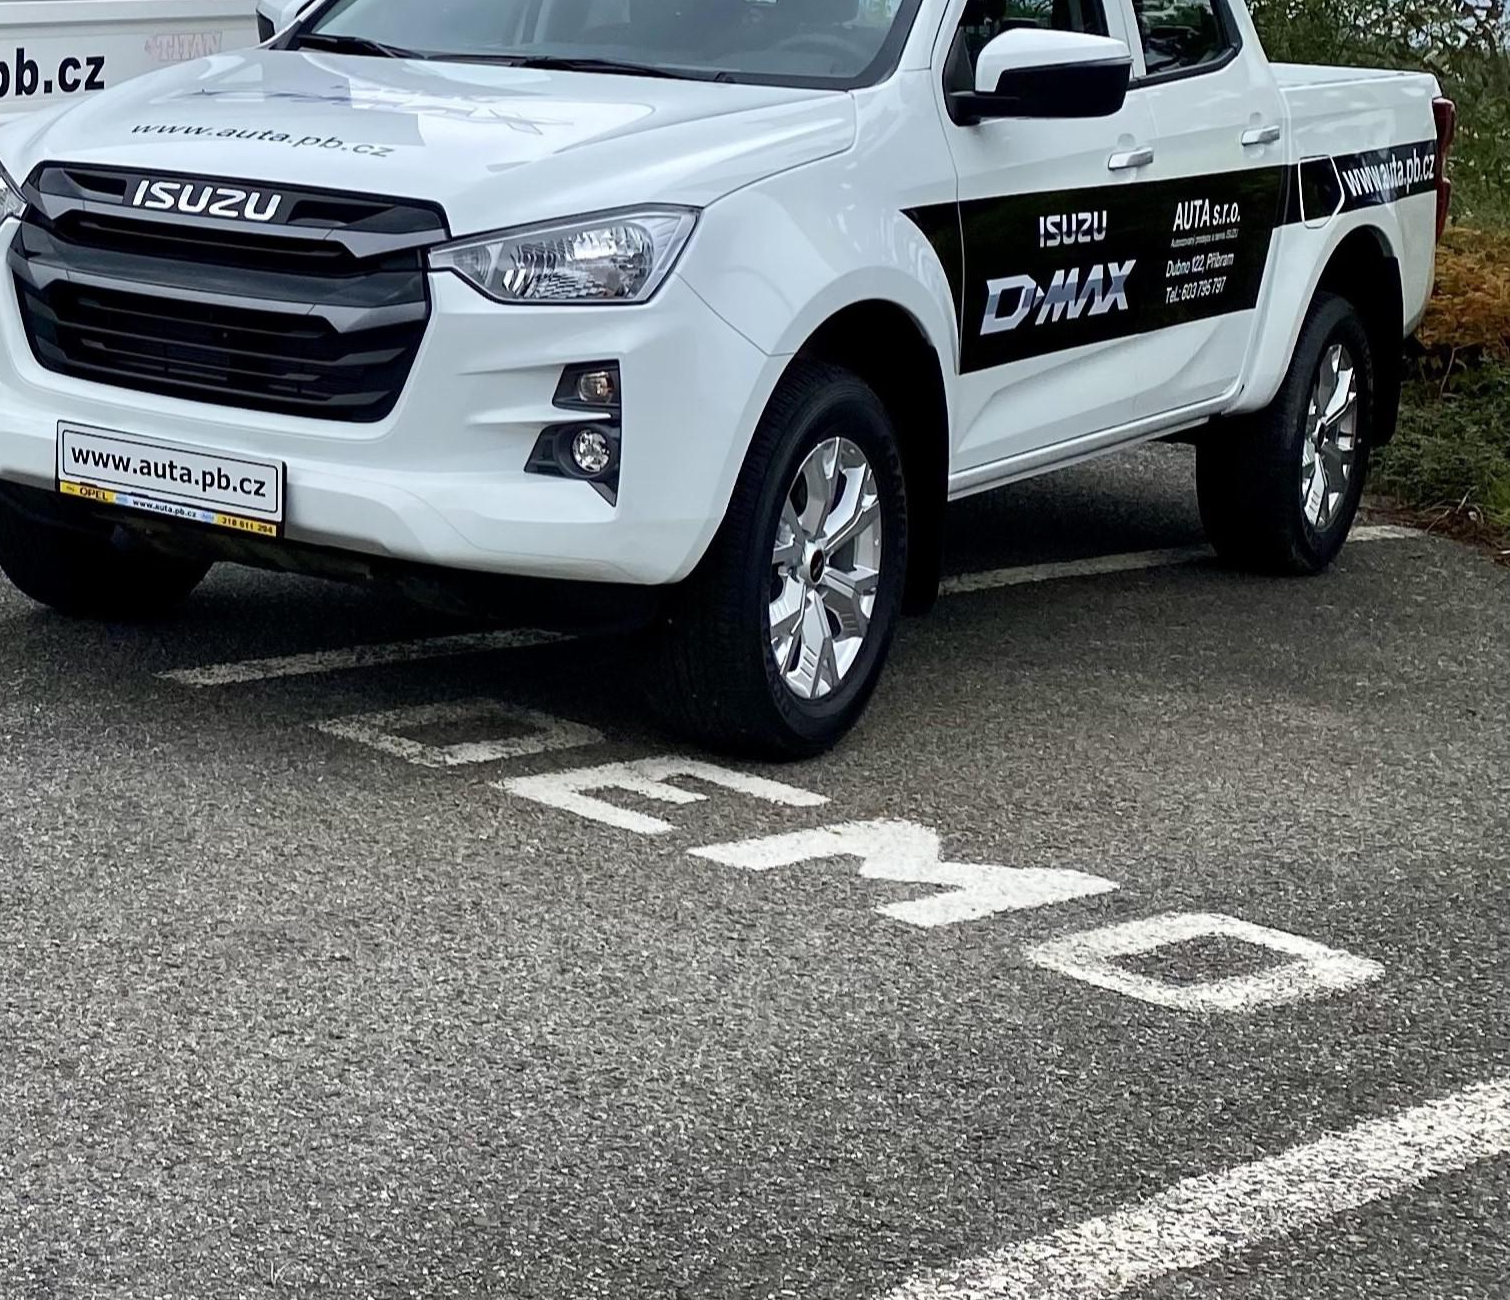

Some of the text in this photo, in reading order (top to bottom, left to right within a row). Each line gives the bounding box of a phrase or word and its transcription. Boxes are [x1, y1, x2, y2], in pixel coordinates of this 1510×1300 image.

[131, 122, 394, 158] www.auta.pb.cz
[1341, 147, 1436, 197] www.auta.pb.cz
[132, 179, 282, 221] ISUZU
[1172, 198, 1241, 231] AUTA s.r.o.
[1039, 210, 1108, 248] ISUZU
[1165, 258, 1191, 278] Dubno
[71, 446, 267, 498] www.auta.pb.cz
[79, 486, 108, 501] OPEL
[132, 499, 197, 518] www.auta.pb.cz
